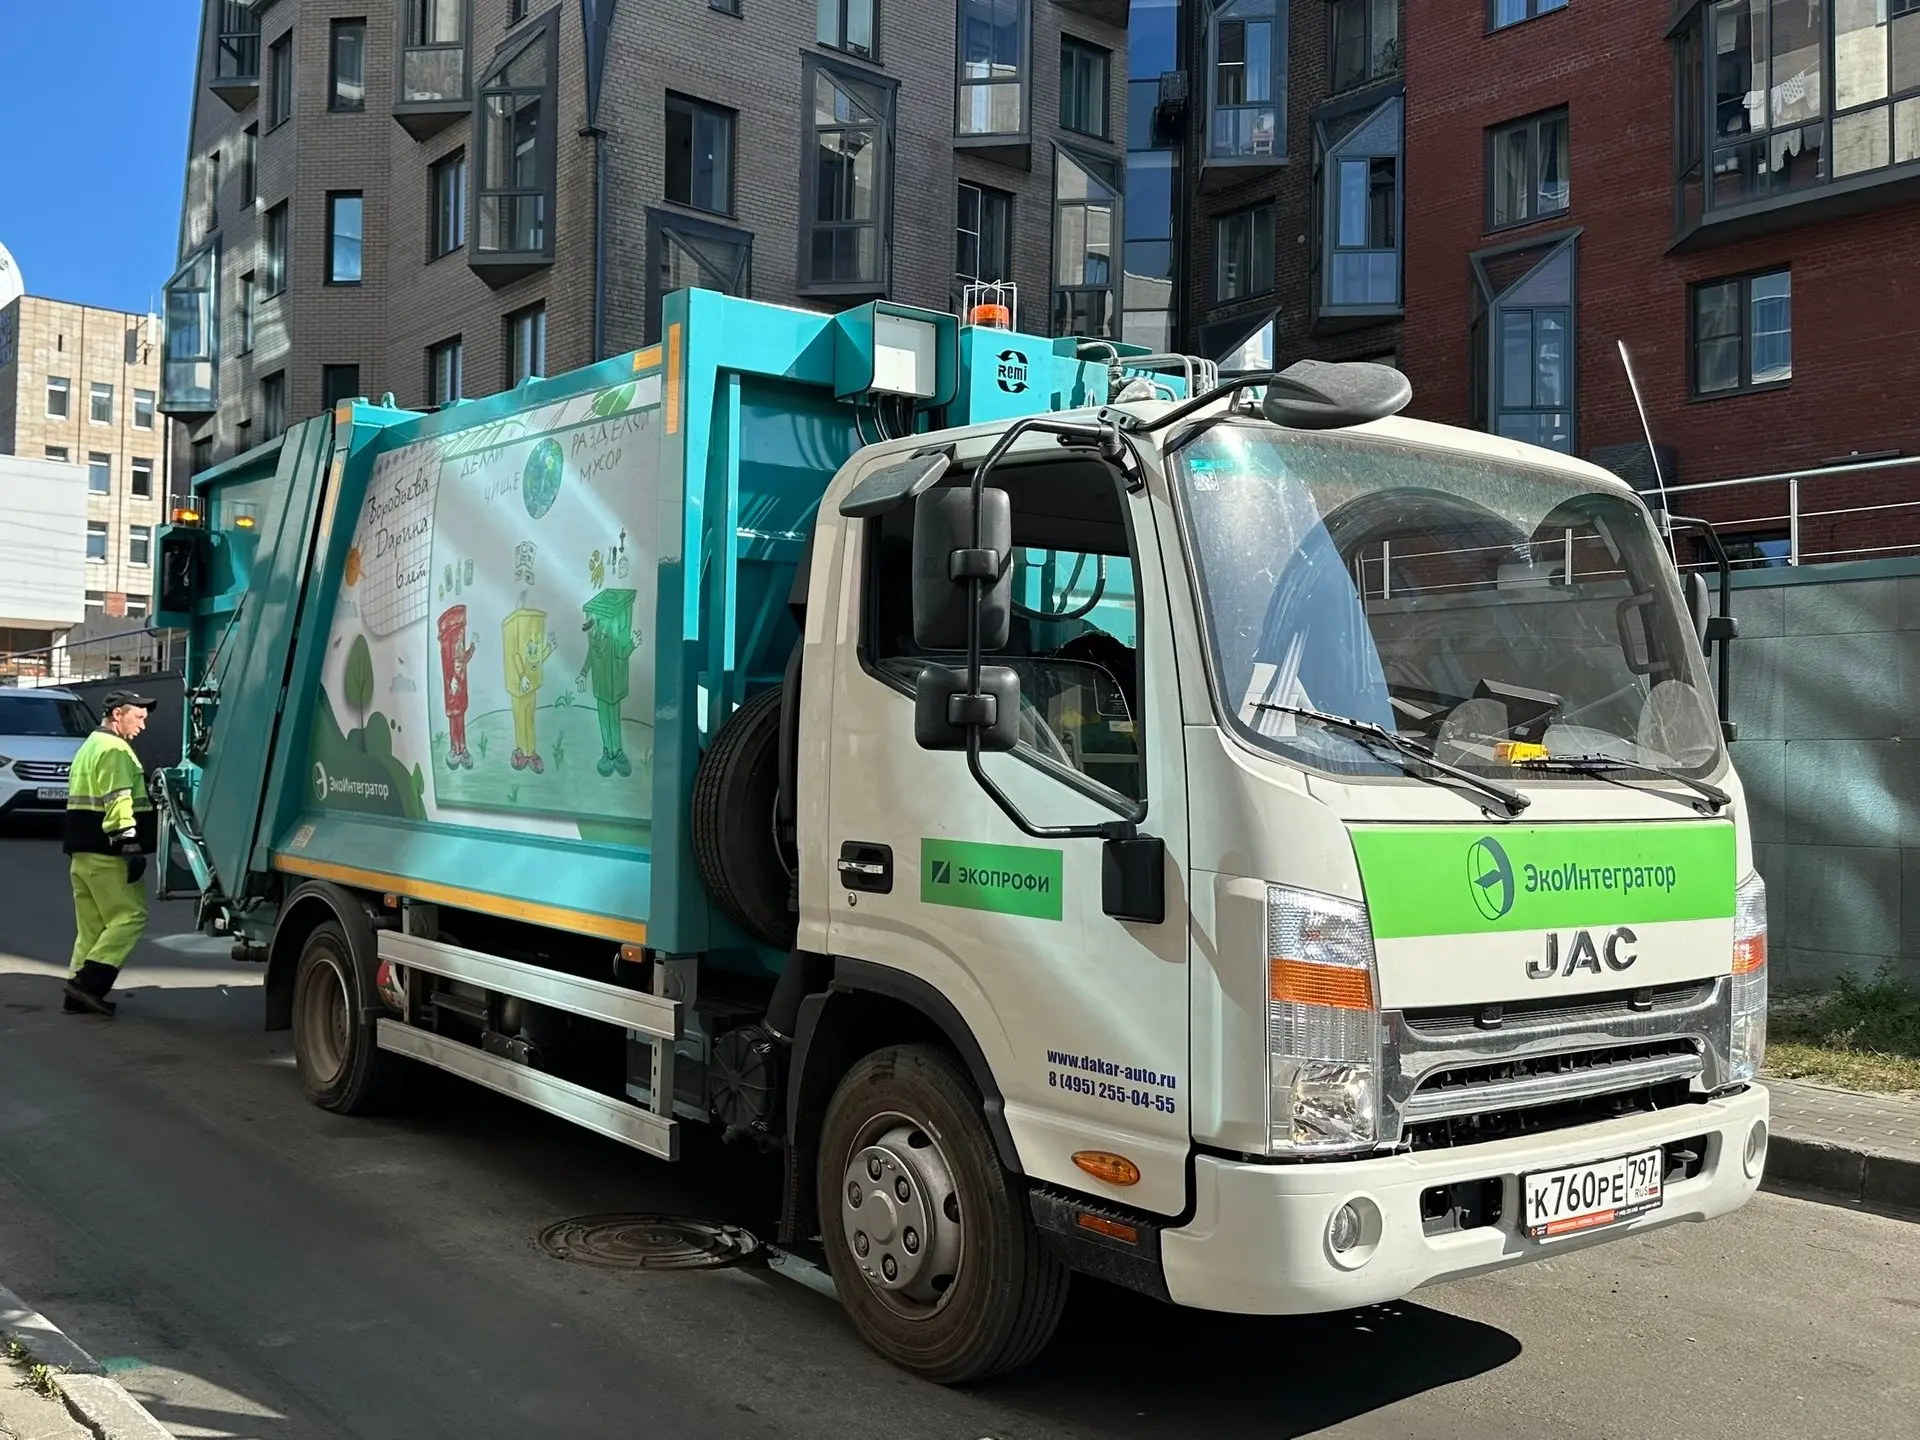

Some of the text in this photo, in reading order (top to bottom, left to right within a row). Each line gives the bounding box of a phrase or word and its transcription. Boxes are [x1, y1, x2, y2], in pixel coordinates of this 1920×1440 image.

[998, 364, 1028, 382] Remi
[579, 448, 622, 483] МУСОР
[375, 517, 428, 559] Дарина
[329, 776, 389, 800] ЭкоИнтегратор
[958, 867, 1050, 893] ЭКОПРОФИ
[1524, 863, 1676, 895] ЭкоИнтегратор
[1525, 926, 1639, 980] JAC
[1046, 1049, 1177, 1089] www.dakar-auto.ru
[1048, 1071, 1176, 1114] 8 (495) 255-04-55
[1628, 1155, 1656, 1189] 797
[1634, 1187, 1648, 1198] RUS
